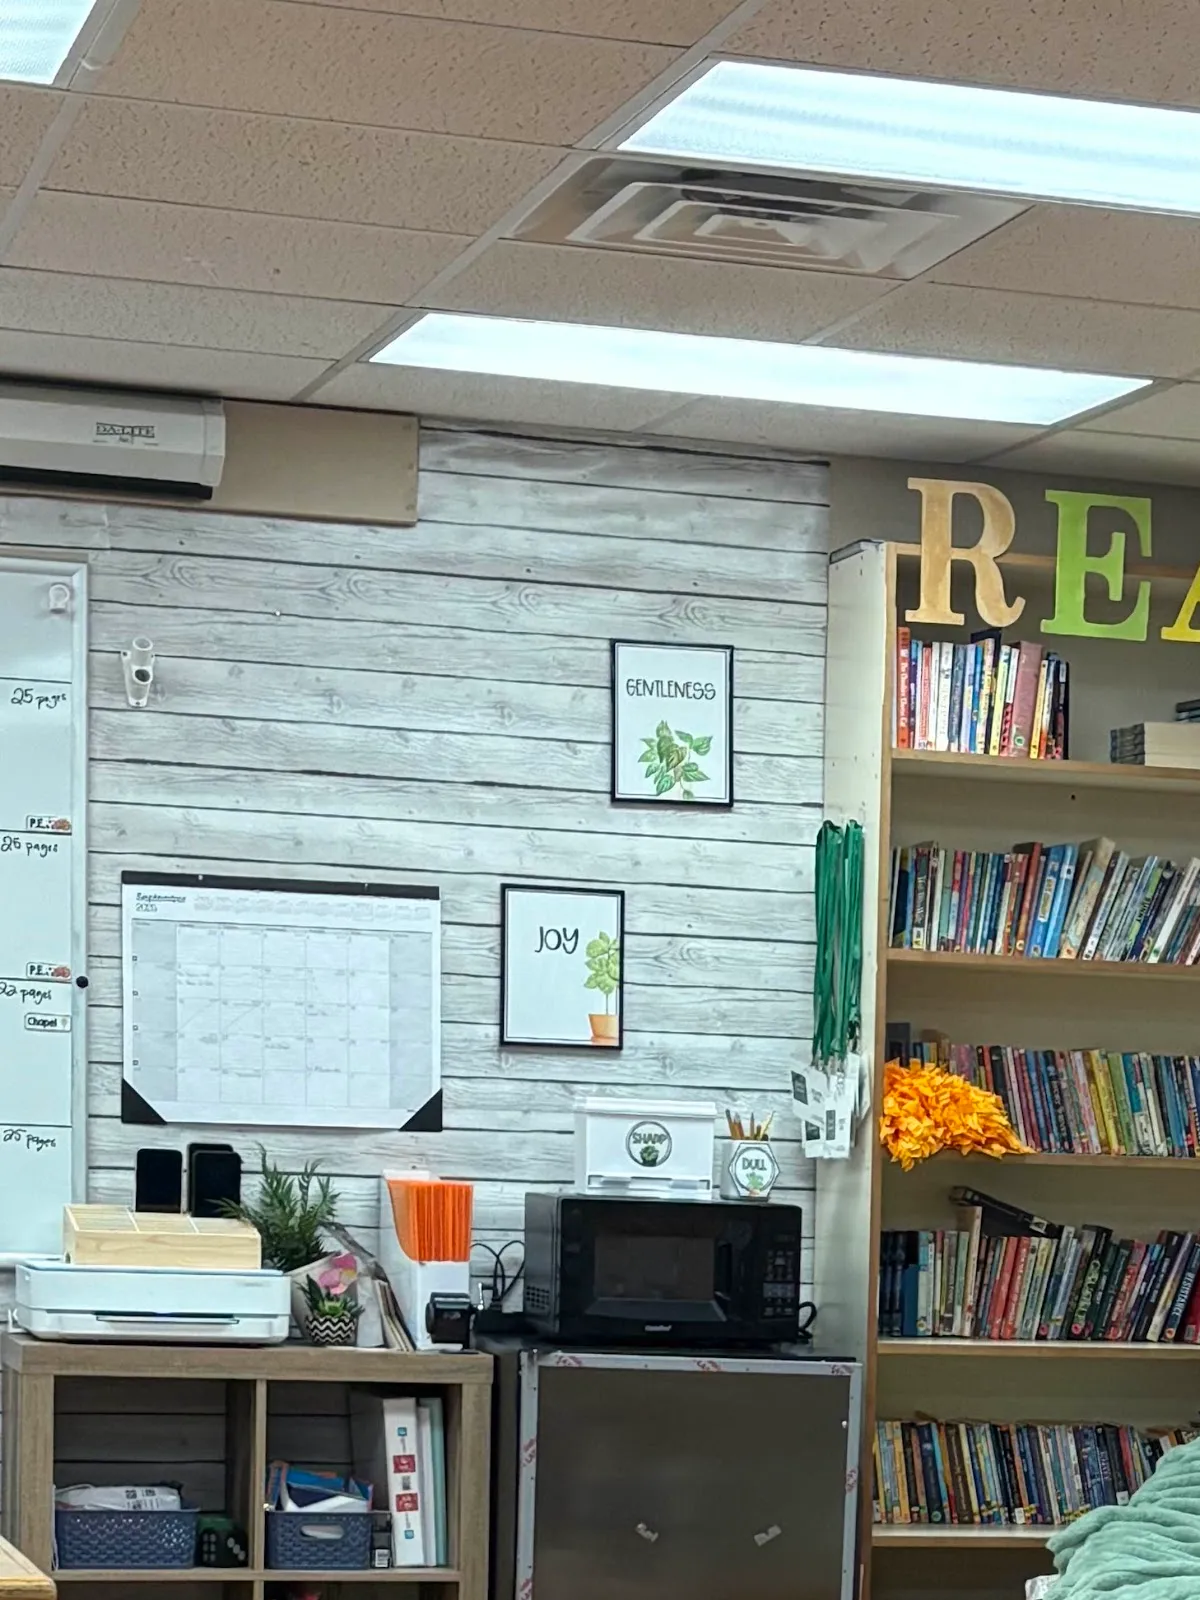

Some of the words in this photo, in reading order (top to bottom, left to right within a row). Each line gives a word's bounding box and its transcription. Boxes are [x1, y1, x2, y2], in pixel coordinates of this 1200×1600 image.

[11, 687, 34, 706] 25
[626, 679, 716, 700] GENTLENESS
[25, 842, 58, 858] pages
[535, 926, 579, 954] JOY
[21, 988, 52, 1005] pages
[28, 1018, 57, 1028] Chapel
[632, 1132, 668, 1145] SHARP
[742, 1157, 767, 1171] DULL
